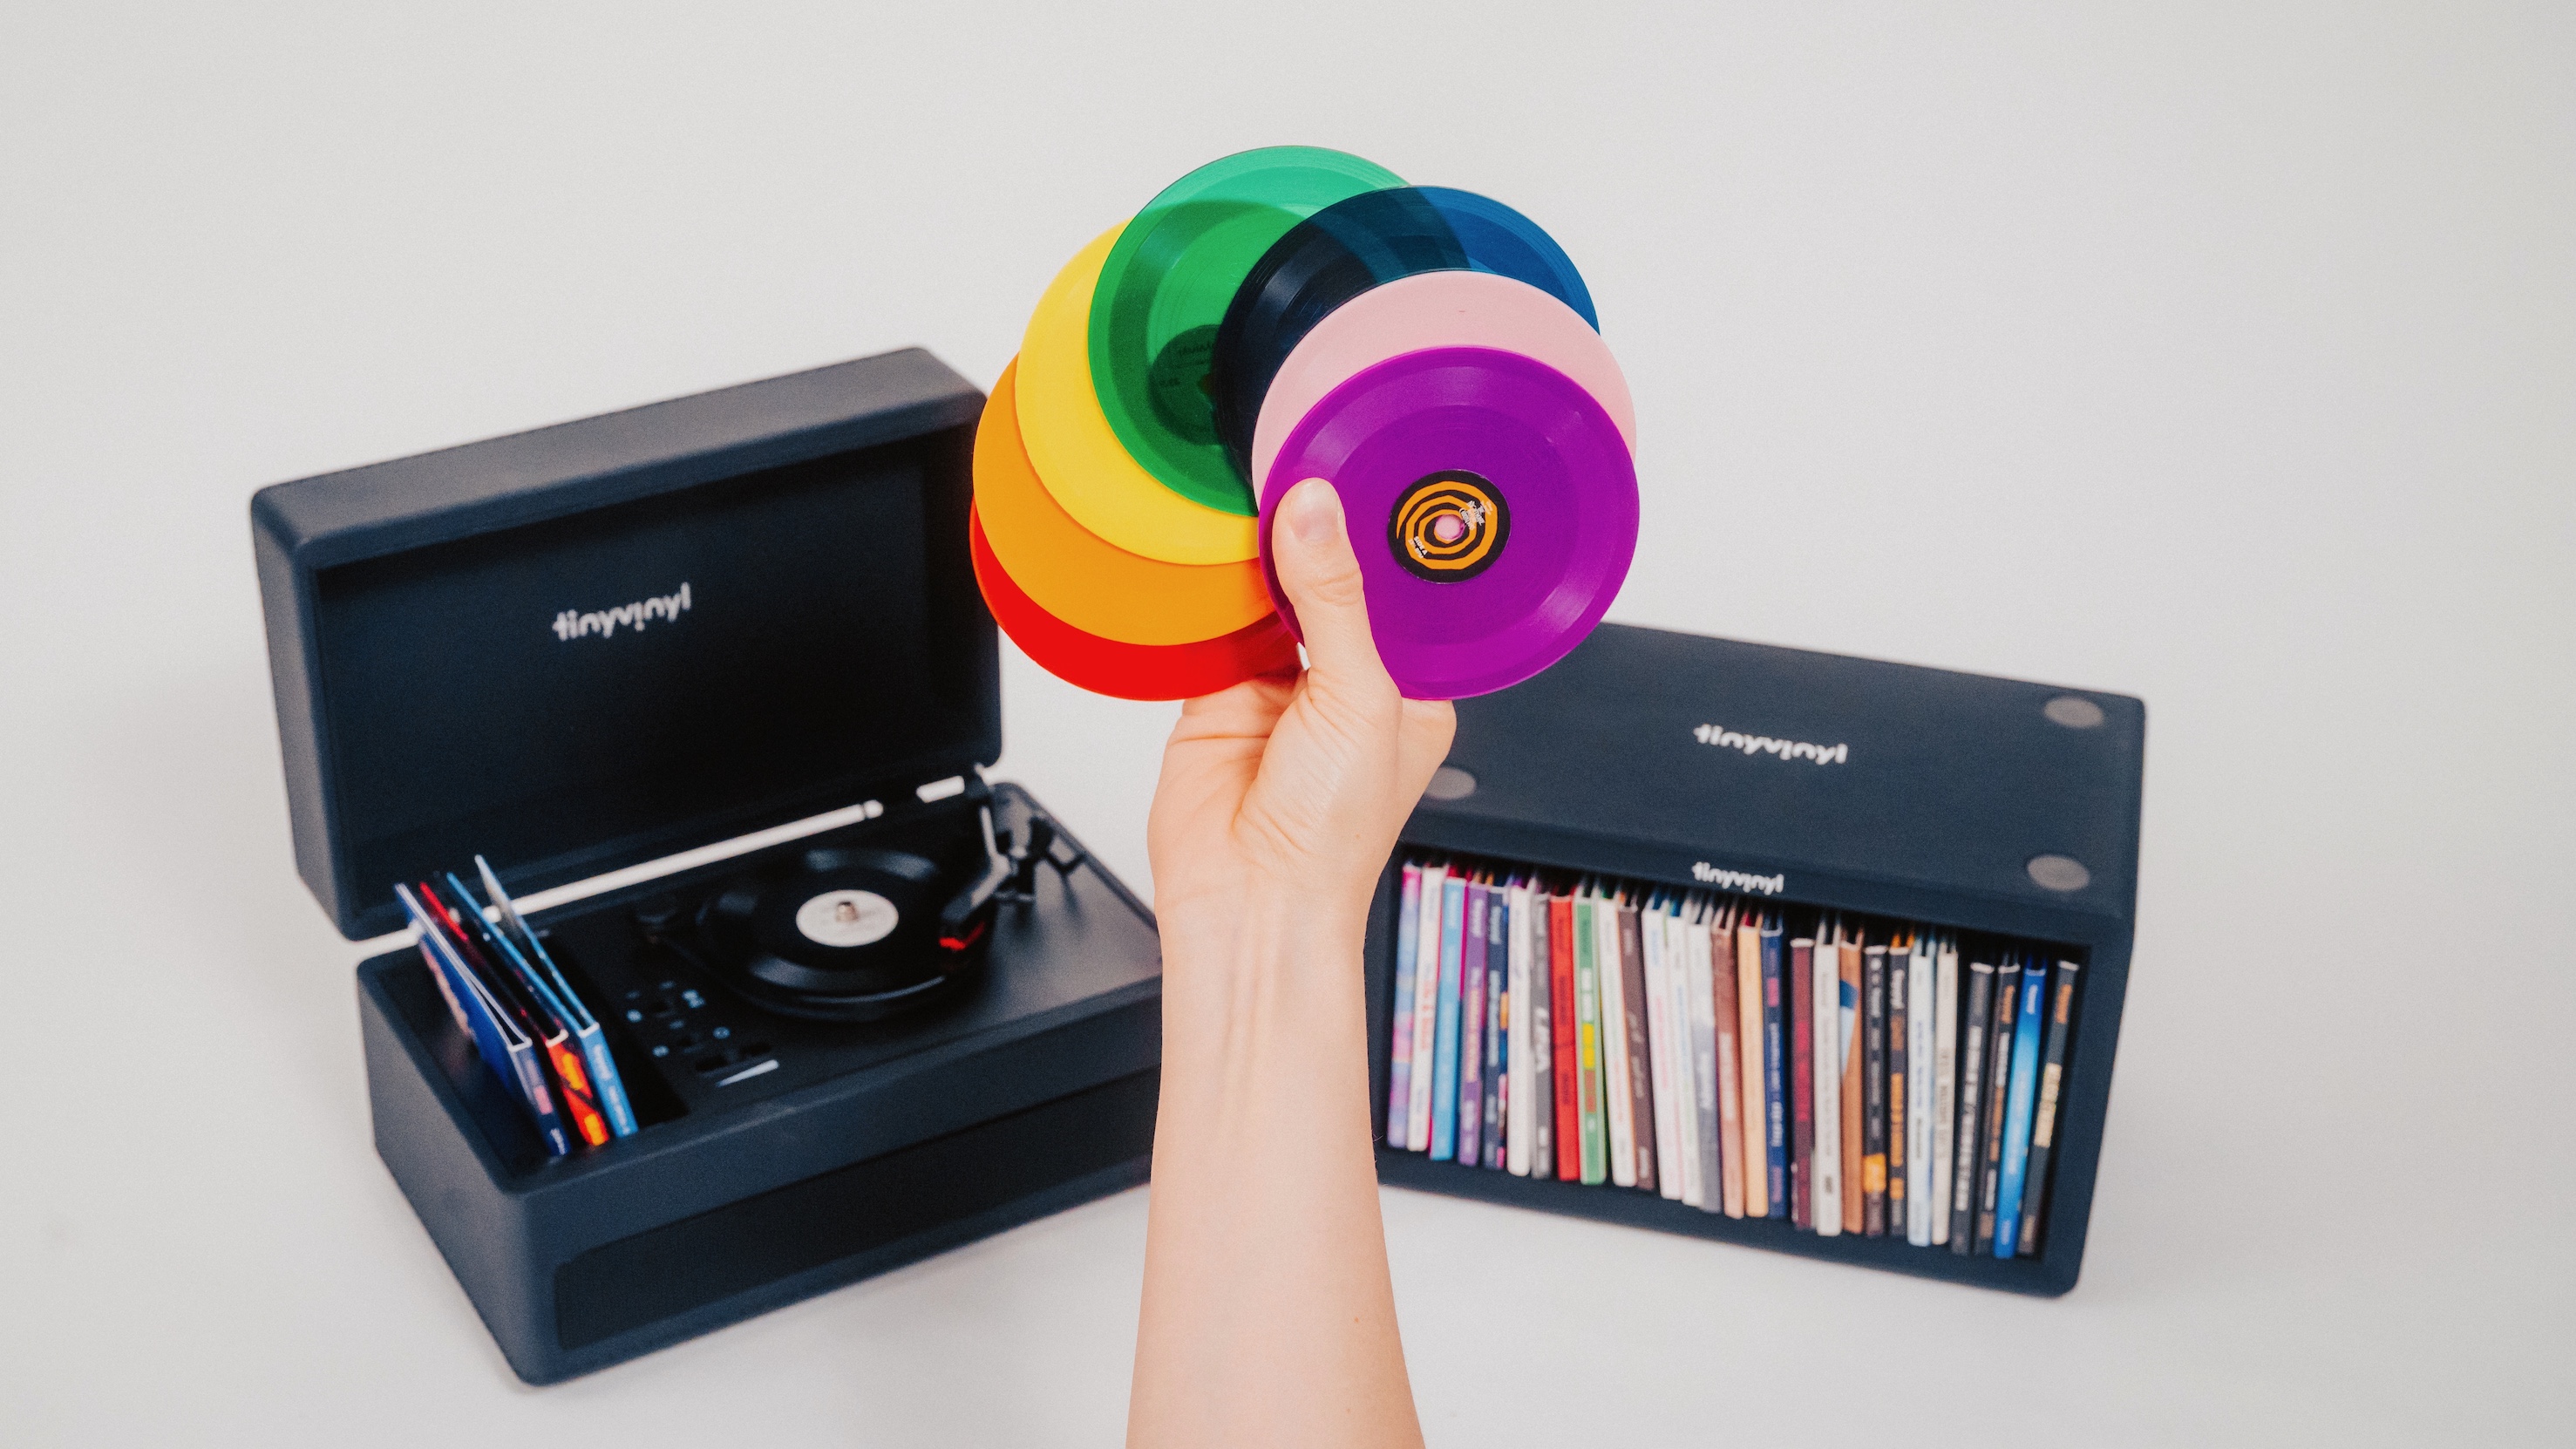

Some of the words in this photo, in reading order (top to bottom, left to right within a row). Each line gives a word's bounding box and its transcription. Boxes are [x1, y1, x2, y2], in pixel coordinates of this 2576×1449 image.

[1414, 535, 1425, 550] SIDE
[552, 581, 692, 642] tinyvinyl
[1693, 723, 1849, 765] tinyvinyl
[1691, 861, 1784, 896] tinyvinyl
